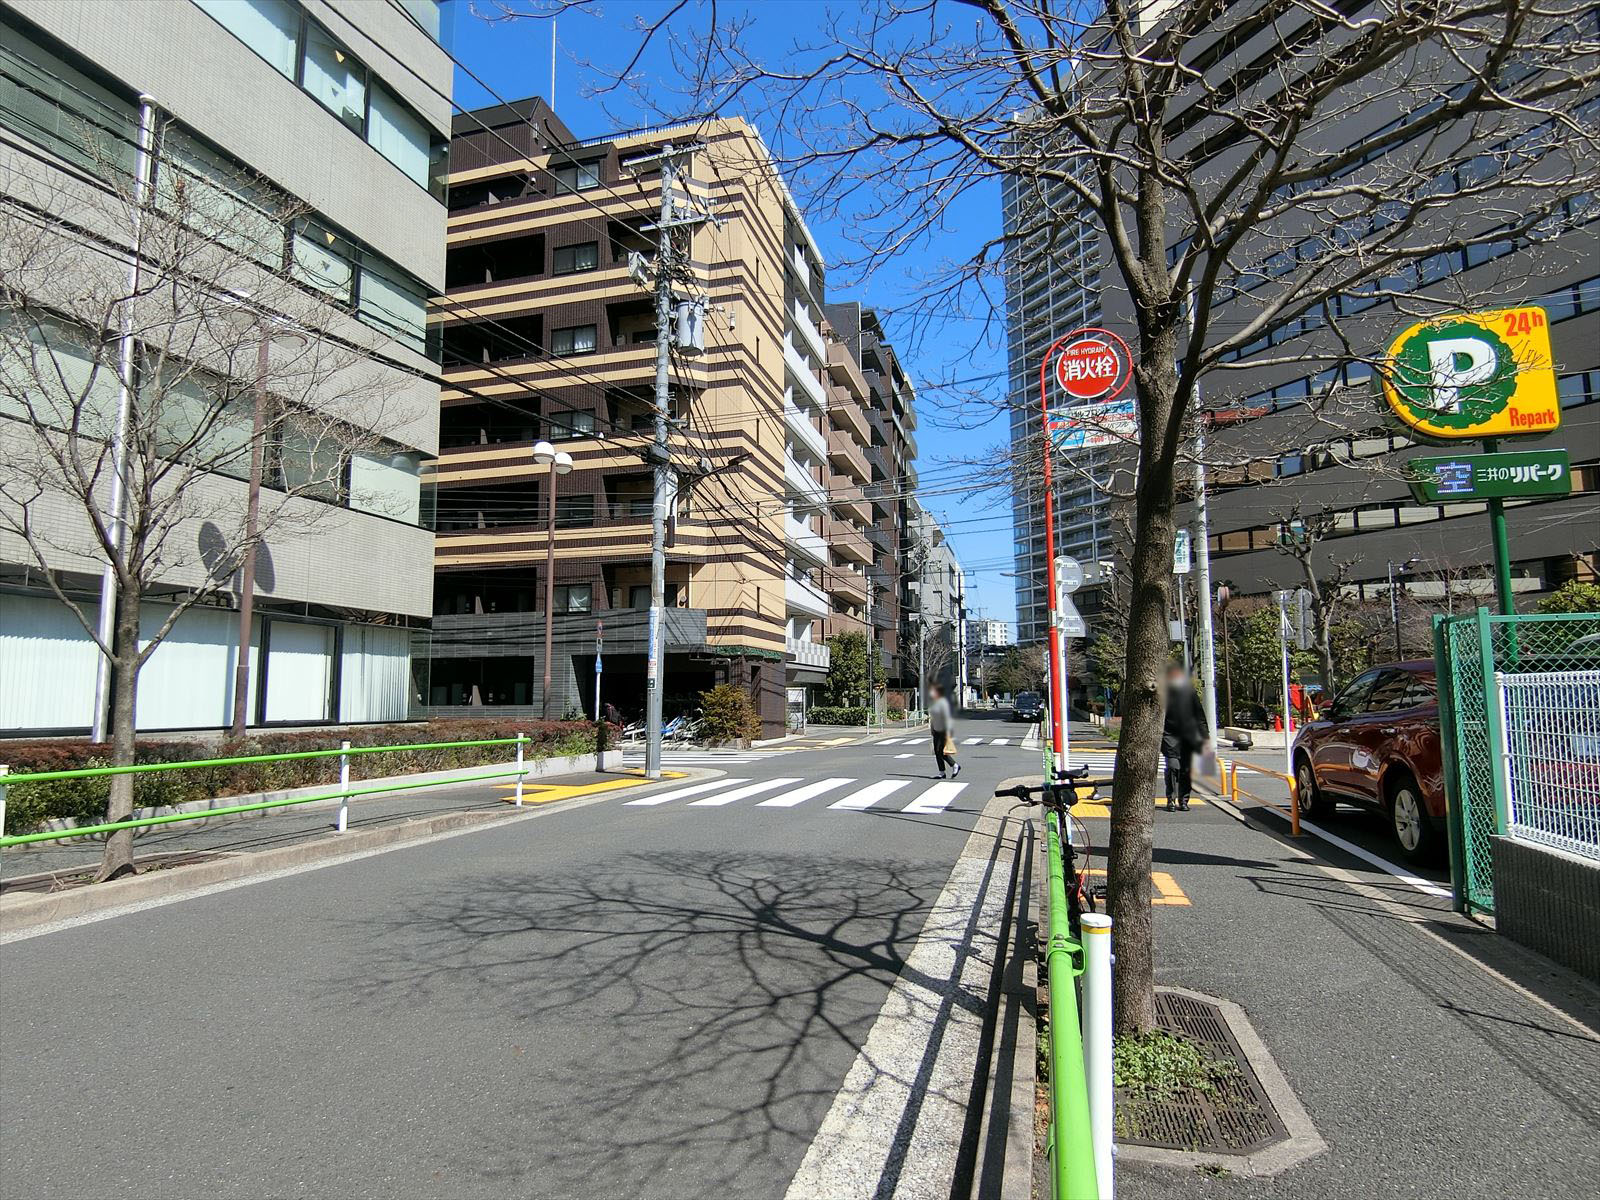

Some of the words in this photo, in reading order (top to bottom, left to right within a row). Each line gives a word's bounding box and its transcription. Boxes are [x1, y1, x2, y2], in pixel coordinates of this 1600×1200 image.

[1504, 312, 1543, 337] 24h
[1081, 345, 1107, 355] HYDRANT
[1063, 355, 1114, 381] 消火栓
[1427, 338, 1496, 415] P
[1509, 408, 1556, 428] Repark
[1476, 463, 1563, 483] 三井のリパーク
